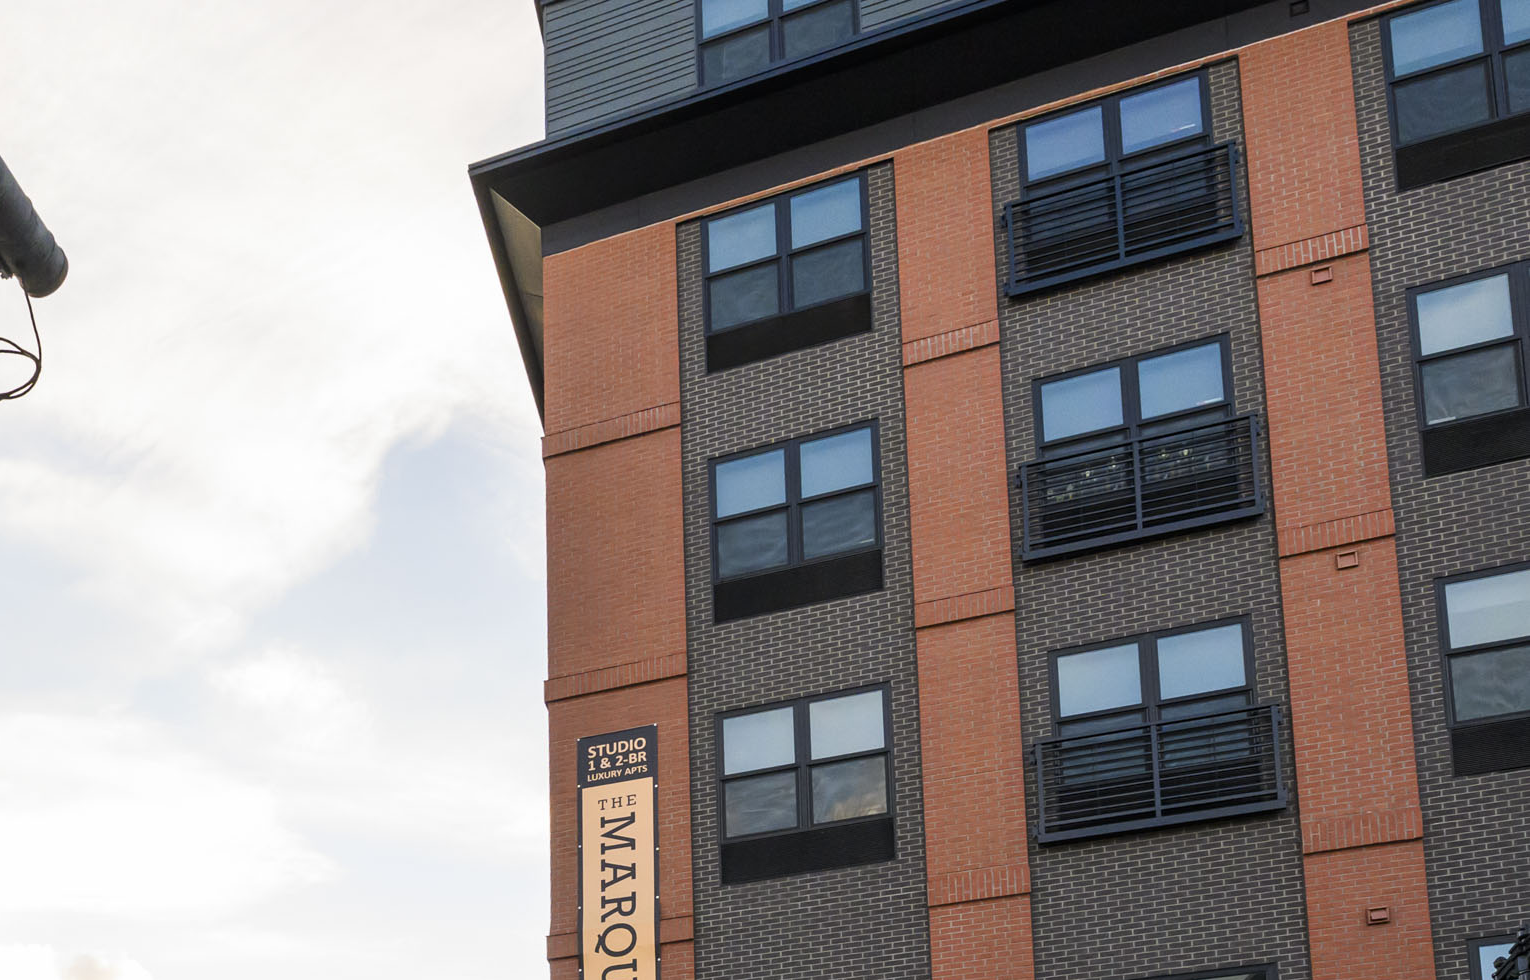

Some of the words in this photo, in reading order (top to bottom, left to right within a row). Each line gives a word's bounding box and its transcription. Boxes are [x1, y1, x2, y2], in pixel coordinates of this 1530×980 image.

[588, 738, 646, 758] STUDIO
[588, 760, 596, 771] 1
[600, 758, 611, 768] &
[616, 752, 646, 766] 2-BR
[587, 769, 622, 782] LUXURY
[624, 765, 648, 775] APTS
[598, 794, 636, 810] THE
